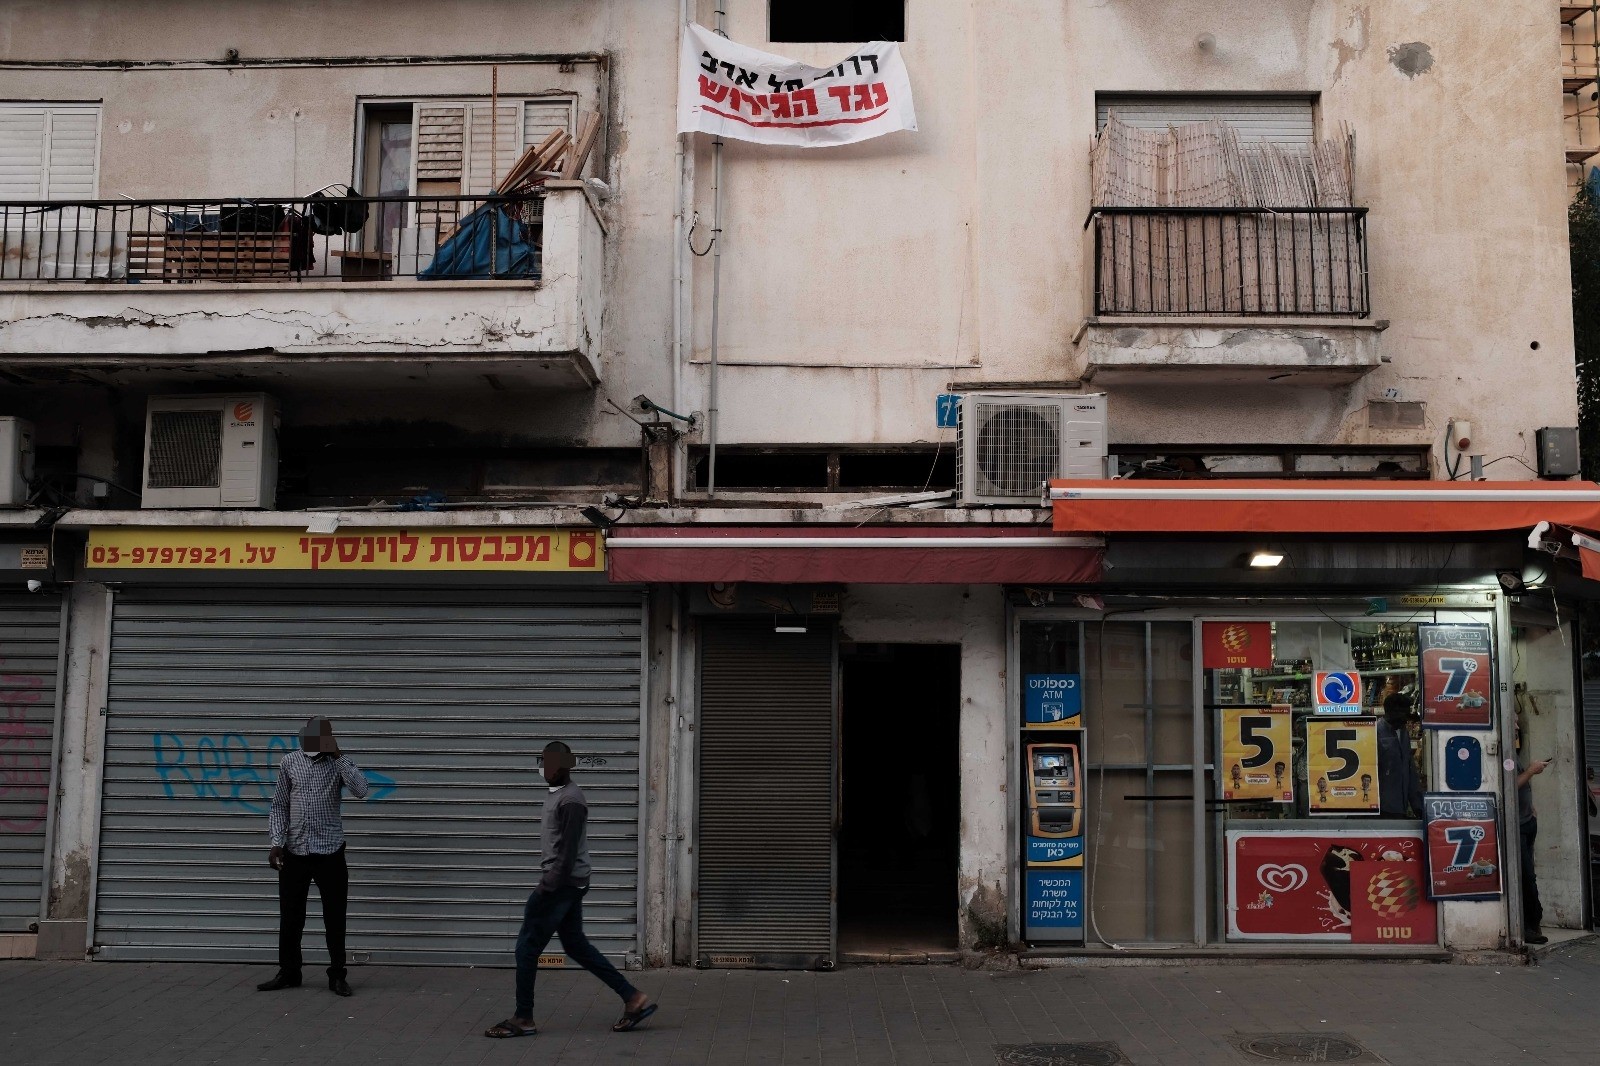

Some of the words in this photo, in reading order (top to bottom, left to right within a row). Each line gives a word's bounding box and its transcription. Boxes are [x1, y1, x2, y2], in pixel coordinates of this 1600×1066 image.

[700, 50, 760, 91] אבב
[814, 54, 879, 81] דרו
[698, 73, 819, 119] הגירוש
[828, 82, 889, 112] נגד
[92, 547, 231, 564] 03-9797921
[239, 543, 277, 564] טל.
[299, 530, 420, 570] לוינסקי
[429, 535, 551, 562] מכבסת
[1427, 630, 1448, 646] 14
[1226, 656, 1247, 664] טוטו
[1439, 657, 1472, 697] 7
[1042, 690, 1063, 699] ATM
[1240, 716, 1274, 769] 5
[1325, 729, 1360, 781] 5
[1432, 801, 1454, 817] 14
[1471, 829, 1484, 837] 1/2
[1047, 848, 1065, 858] כאן
[1445, 826, 1479, 867] 7
[1039, 879, 1071, 887] המכשיר
[1031, 898, 1061, 910] לקוחות
[1063, 900, 1077, 908] את
[1032, 911, 1063, 920] הבנקים
[1065, 909, 1077, 918] כל
[1376, 926, 1412, 939] טוטו
